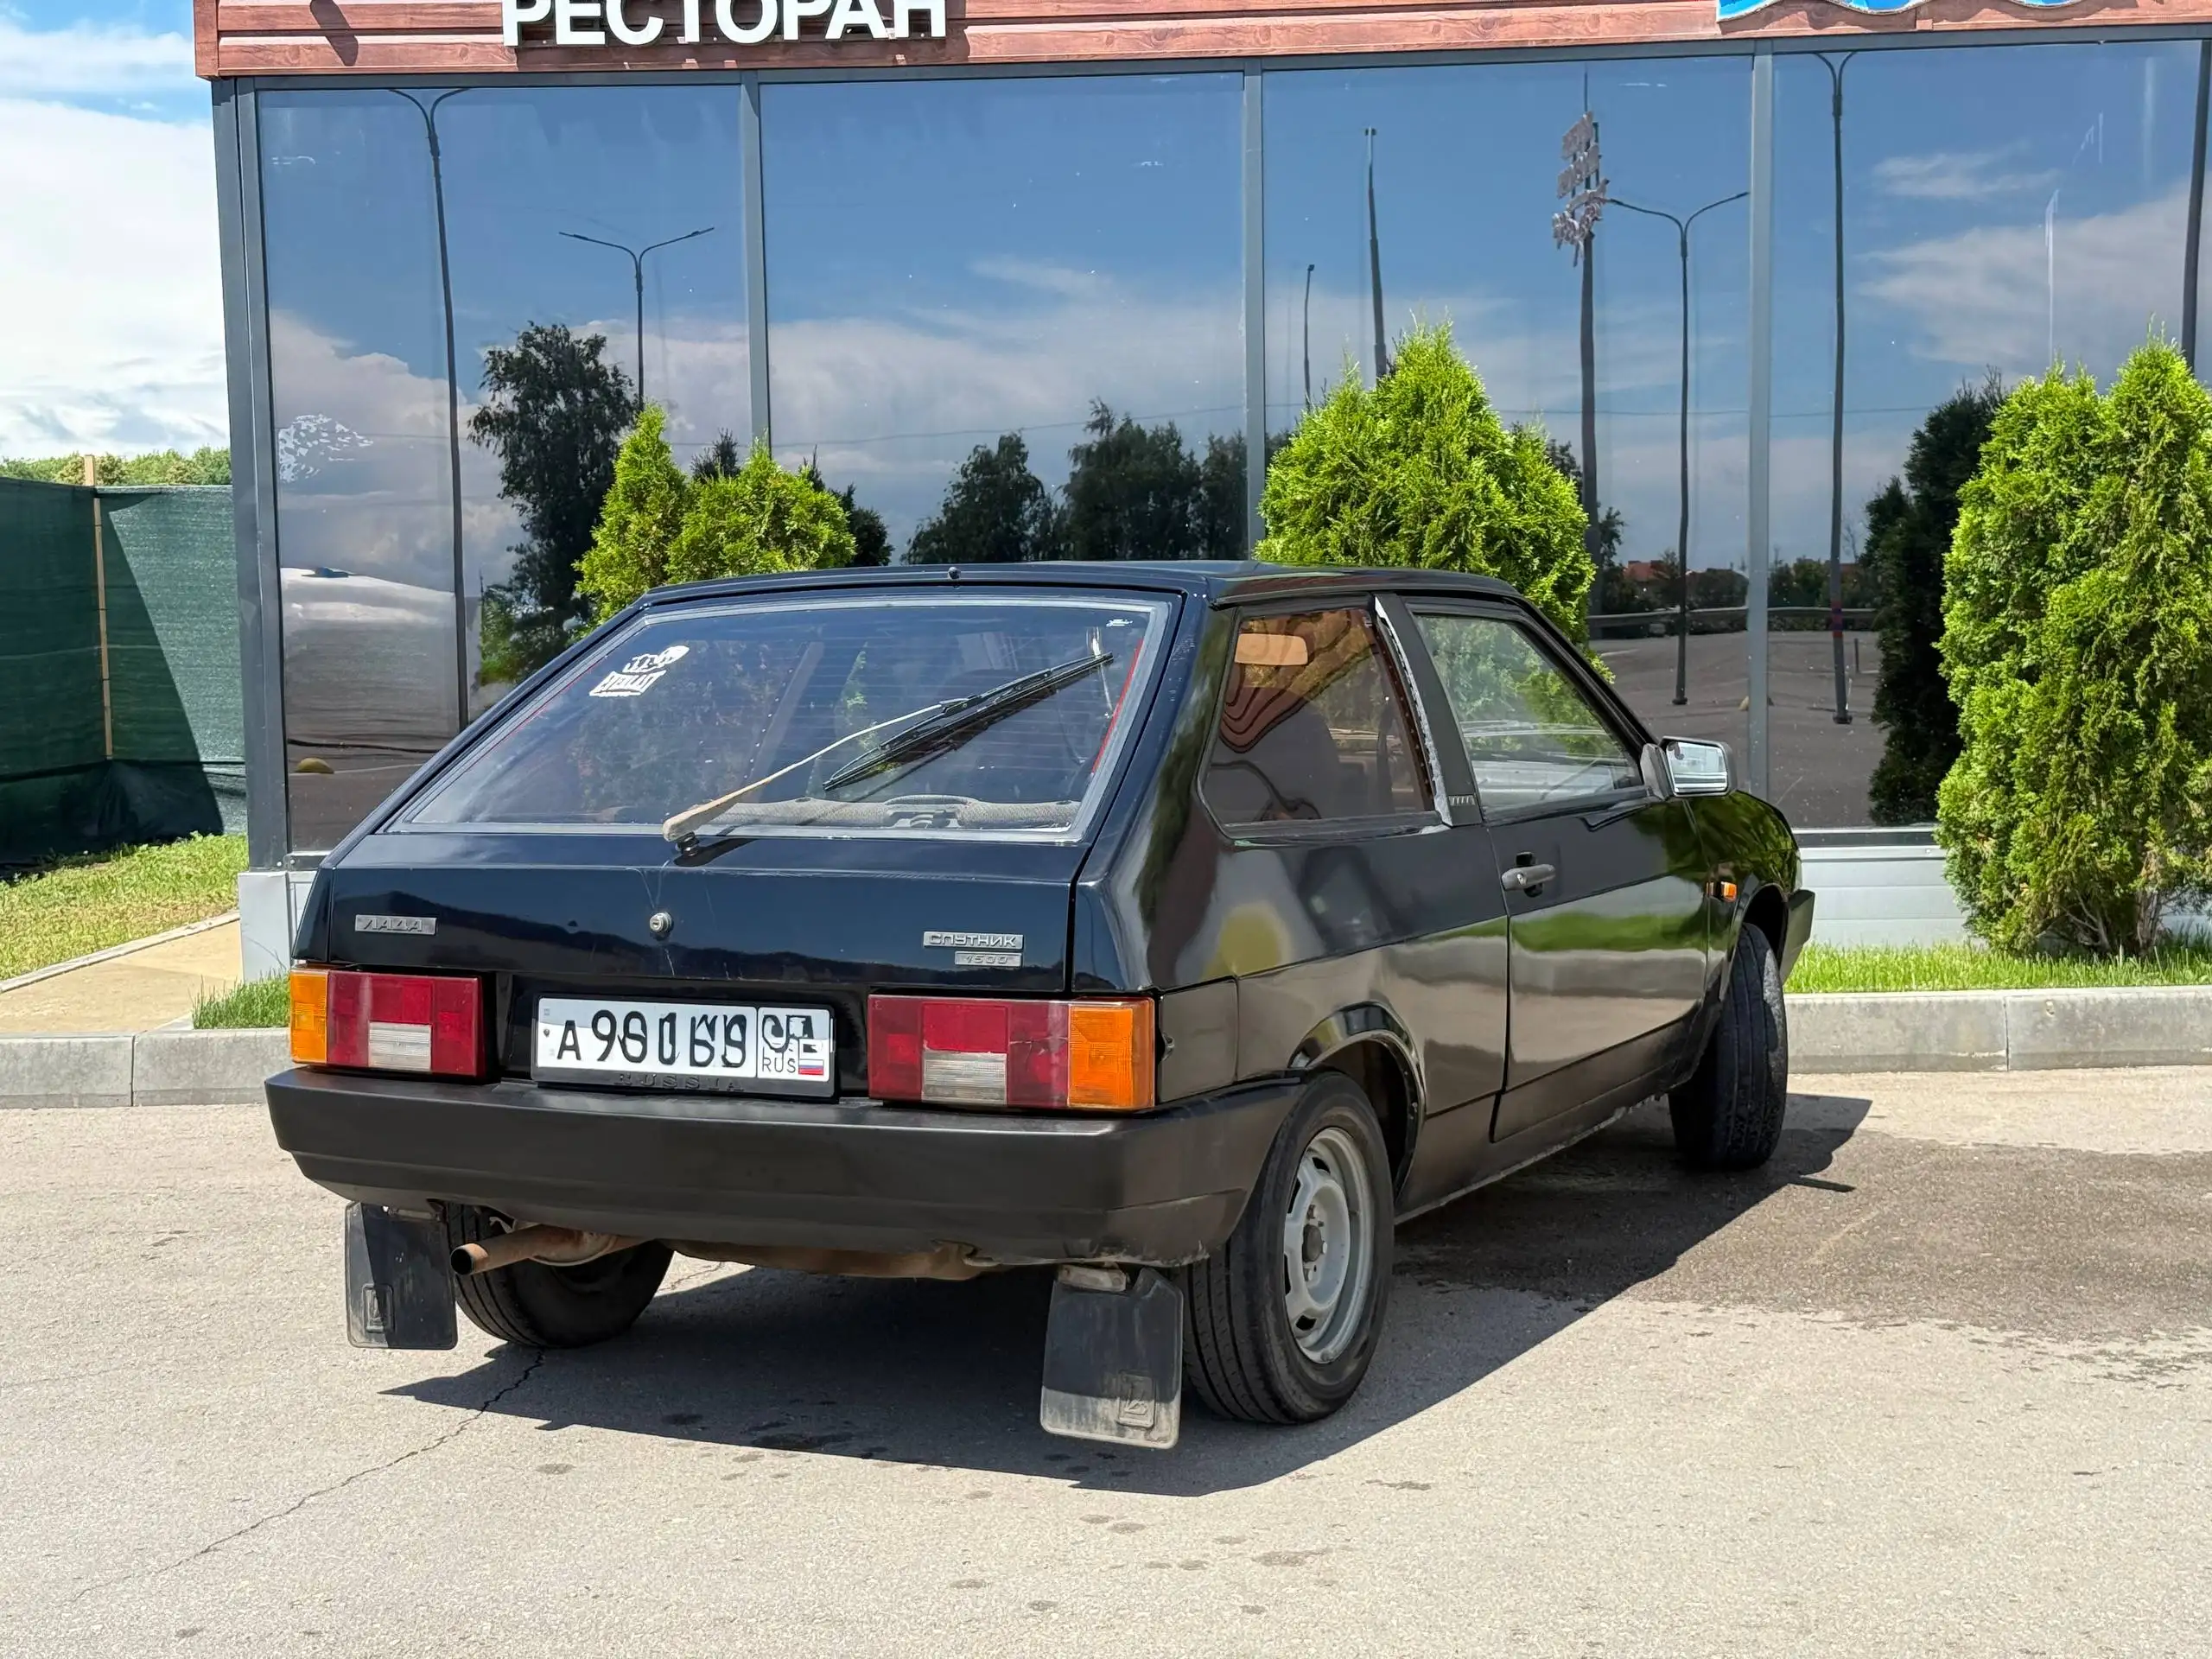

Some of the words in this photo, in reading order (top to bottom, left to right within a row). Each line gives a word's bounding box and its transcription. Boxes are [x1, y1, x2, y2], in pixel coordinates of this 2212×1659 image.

[929, 933, 1016, 948] СПУТНИК
[762, 1056, 796, 1073] RUS
[613, 1071, 745, 1093] RUSSIA
